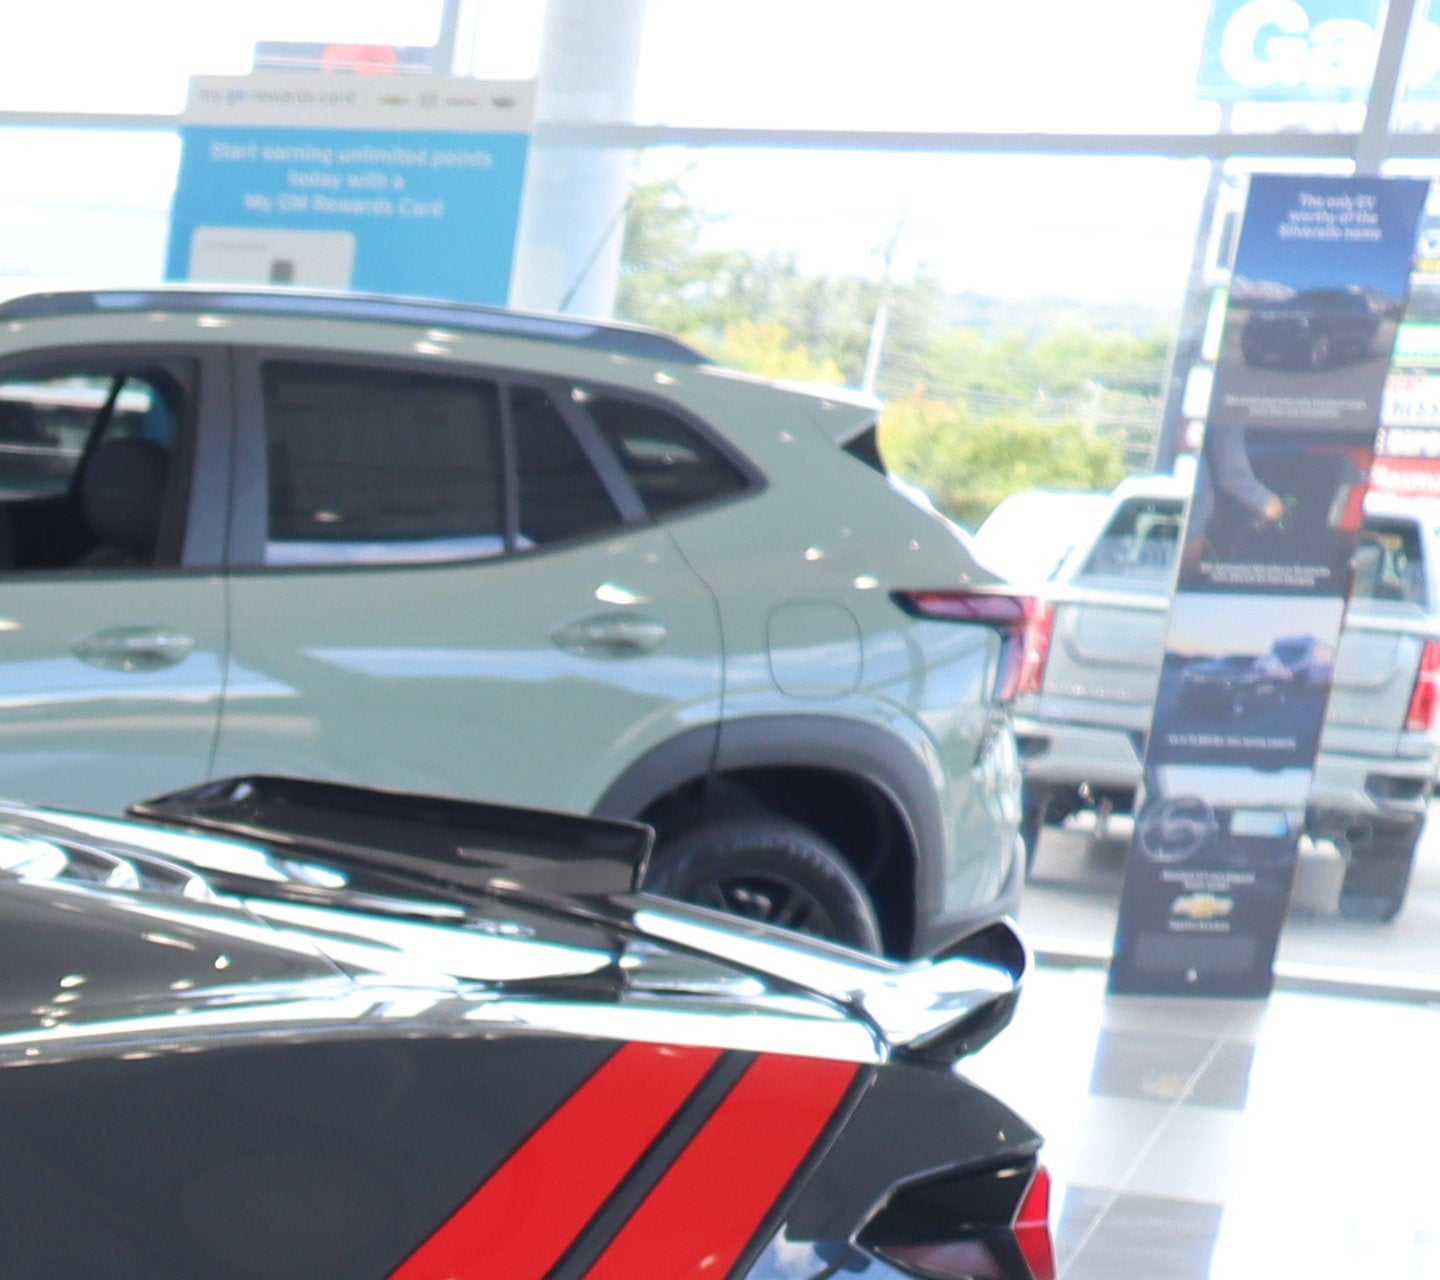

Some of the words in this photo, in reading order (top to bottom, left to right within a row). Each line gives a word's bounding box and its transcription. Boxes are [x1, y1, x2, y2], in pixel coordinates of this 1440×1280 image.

[1220, 0, 1440, 88] Ga
[209, 140, 260, 162] Start
[312, 195, 394, 216] Rewards
[400, 197, 445, 218] Card
